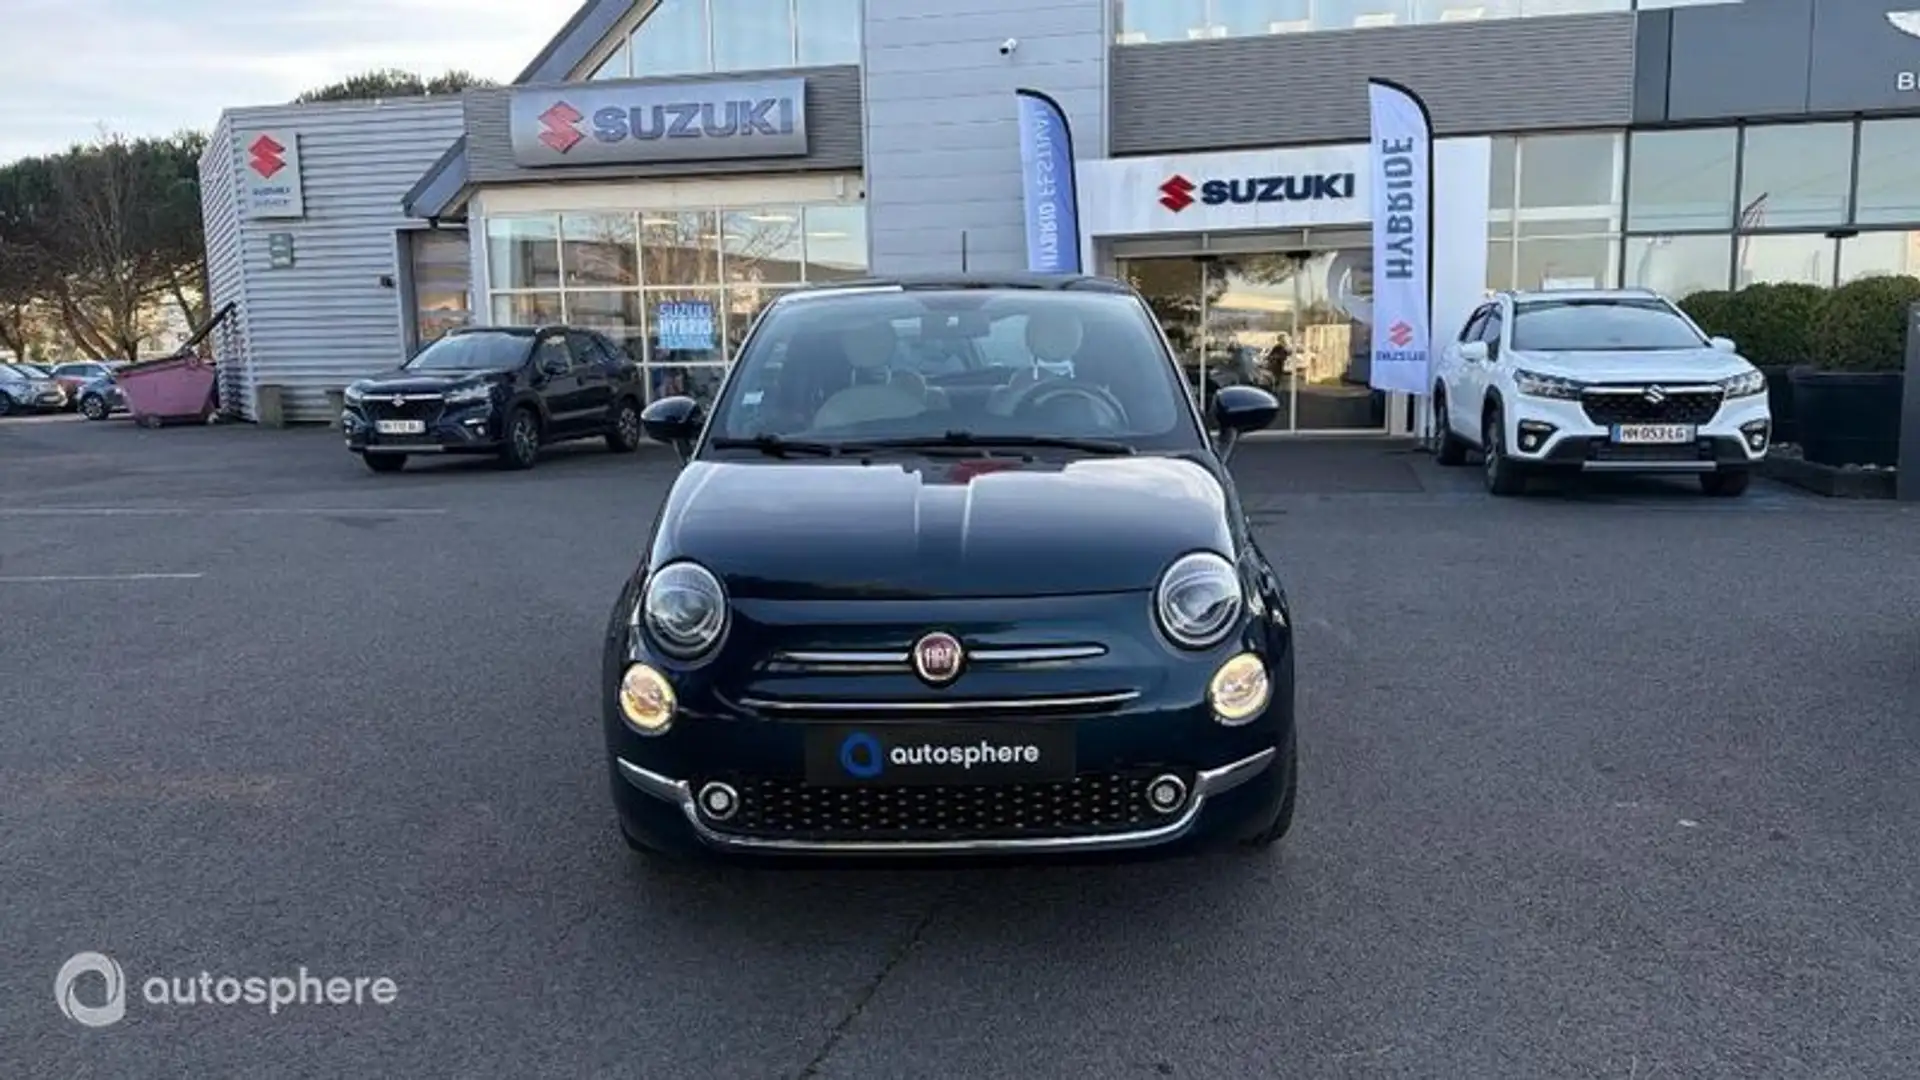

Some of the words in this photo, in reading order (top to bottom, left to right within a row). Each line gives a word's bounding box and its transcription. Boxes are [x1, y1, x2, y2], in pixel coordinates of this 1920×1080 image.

[1898, 72, 1920, 91] B
[592, 97, 794, 143] SUZUKI
[1201, 172, 1355, 205] SUZUKI
[925, 647, 952, 669] FIAT
